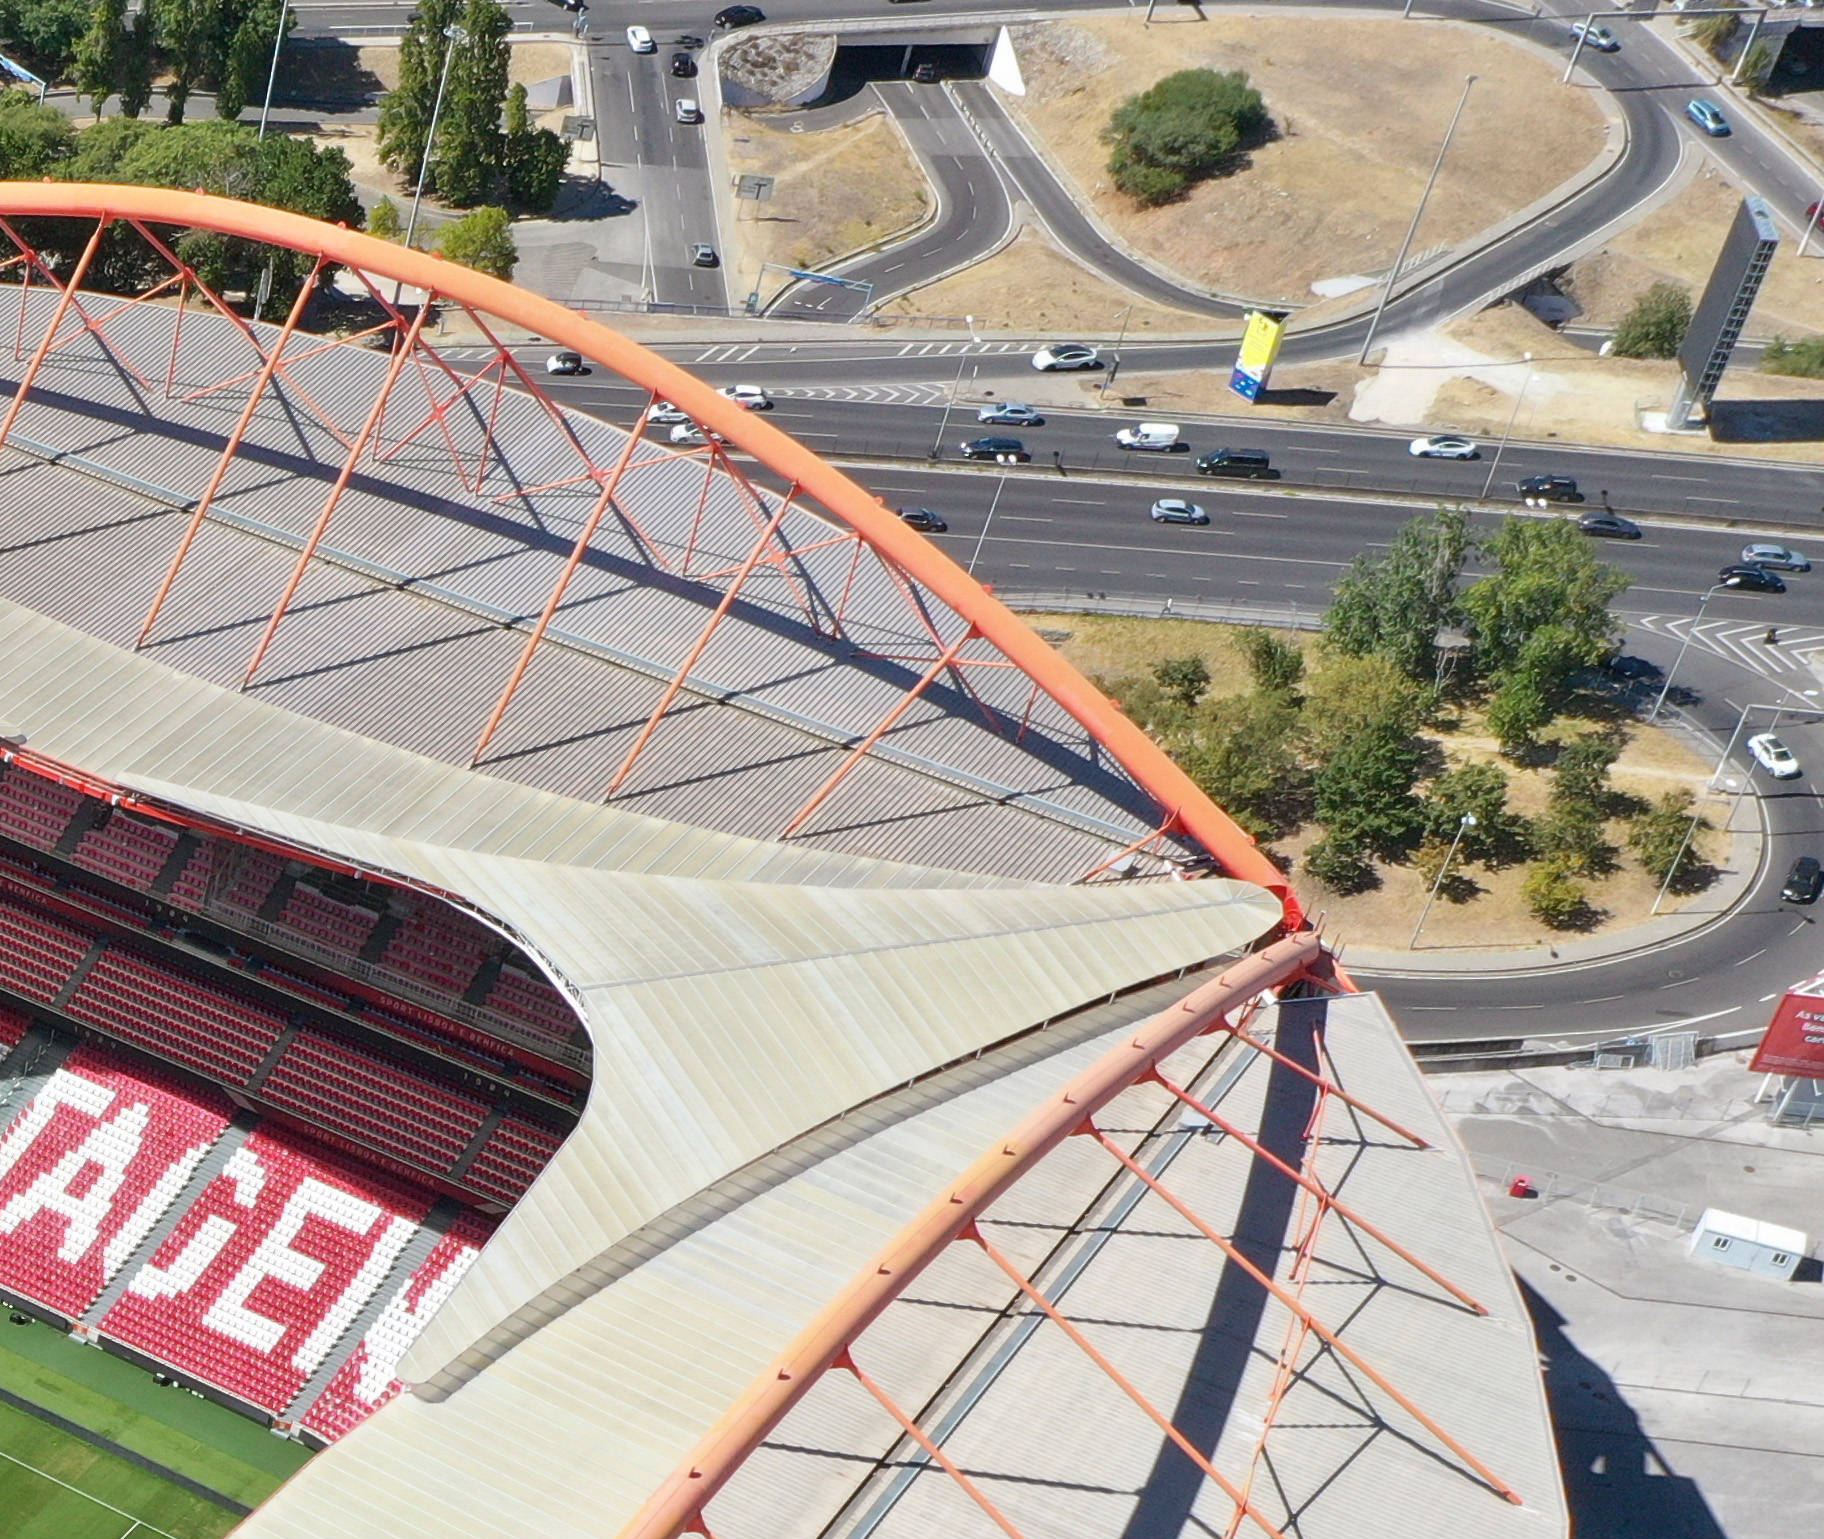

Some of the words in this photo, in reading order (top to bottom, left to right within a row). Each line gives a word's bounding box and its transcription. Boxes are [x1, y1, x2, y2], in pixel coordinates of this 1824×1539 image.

[379, 995, 413, 1015] SPORT
[417, 1010, 455, 1032] LISBOA
[469, 1031, 515, 1057] BENFICA
